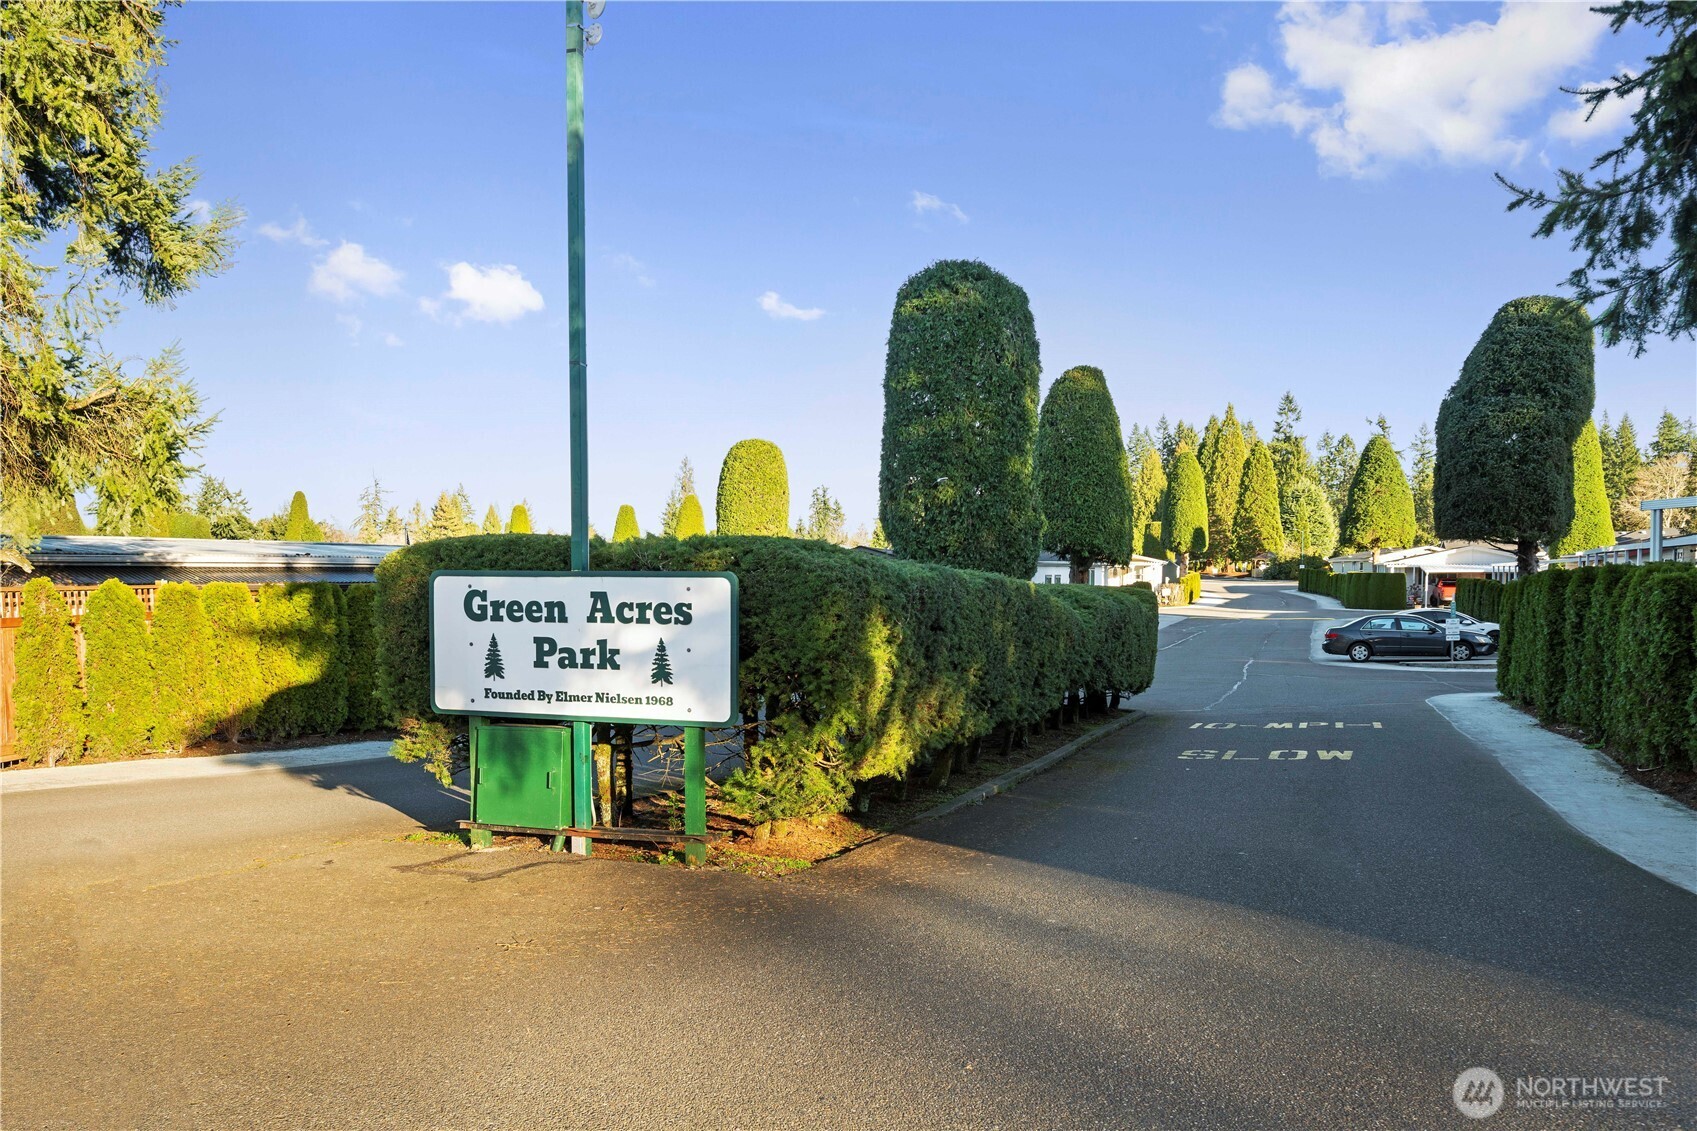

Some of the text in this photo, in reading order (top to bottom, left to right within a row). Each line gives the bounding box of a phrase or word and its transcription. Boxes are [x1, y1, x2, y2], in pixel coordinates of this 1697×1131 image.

[463, 588, 693, 625] Green Acres
[533, 636, 620, 670] Park
[484, 688, 674, 706] Founded By Elmer Nielsen 1968
[1177, 750, 1354, 760] SLOW
